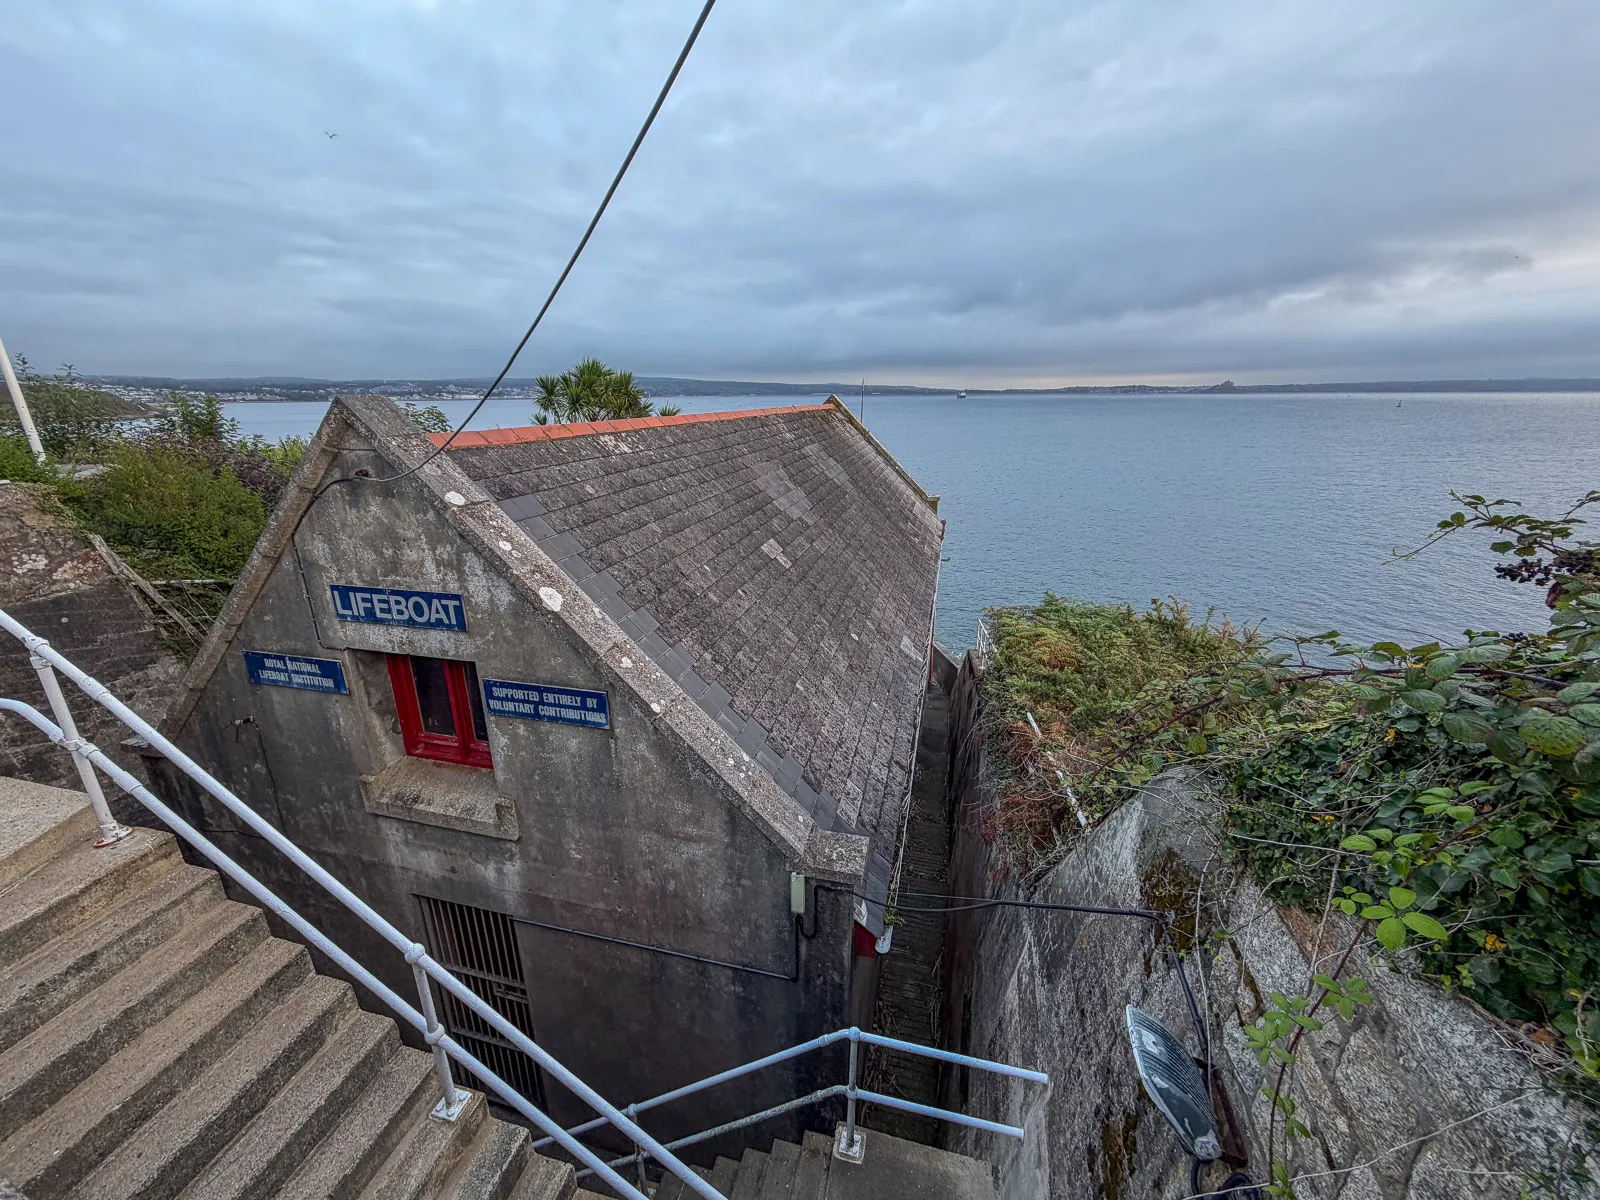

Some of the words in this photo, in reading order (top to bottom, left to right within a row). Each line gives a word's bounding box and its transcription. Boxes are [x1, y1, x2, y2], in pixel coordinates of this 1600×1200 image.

[333, 590, 460, 625] LIFEBOAT
[264, 658, 286, 669] ROYAL
[286, 660, 321, 673] NATIONAL
[258, 669, 289, 682] LIFEBOAT
[291, 673, 334, 687] INSTITUTION
[491, 686, 540, 701] SUPPORTED
[542, 692, 581, 707] ENTIRELY
[586, 697, 597, 709] BY
[488, 699, 535, 714] VOLUNTARY
[538, 705, 606, 723] CONTRIBUTIONS
